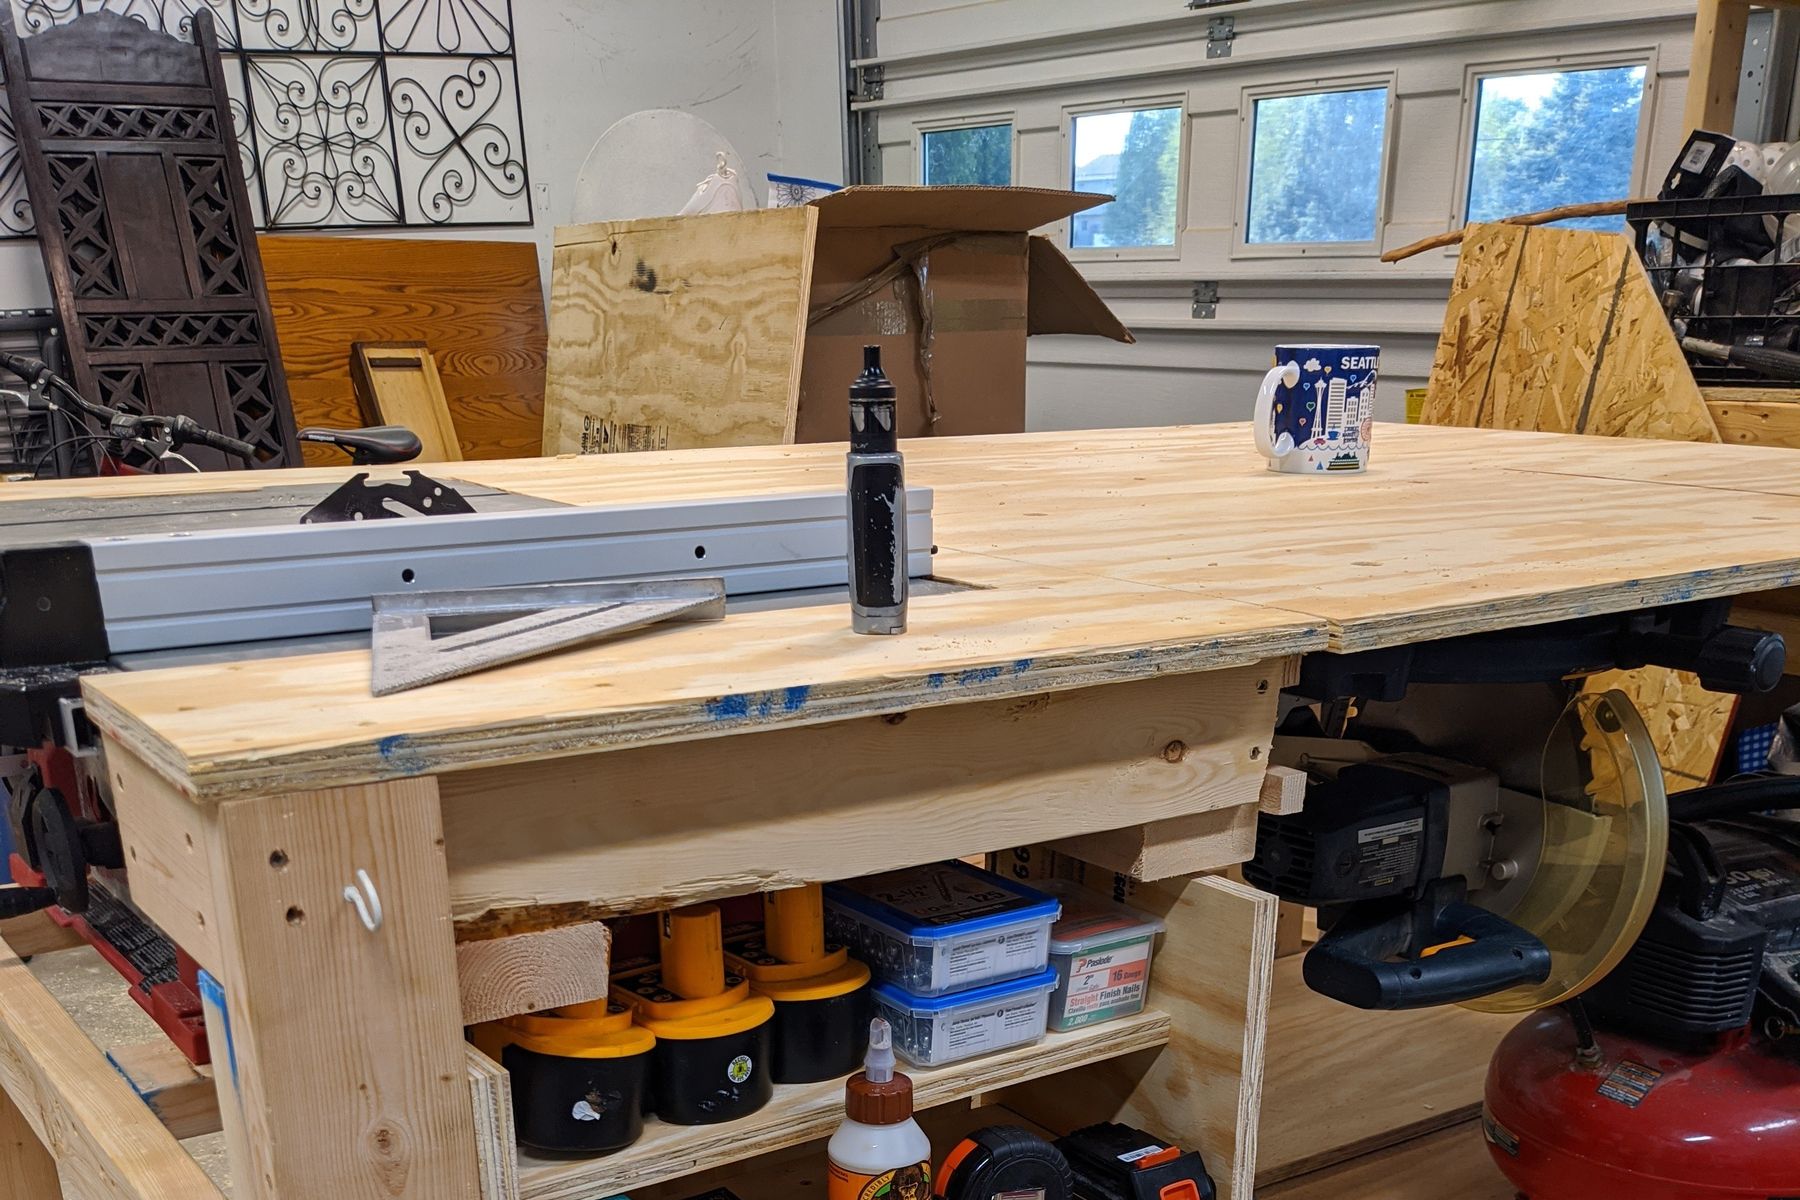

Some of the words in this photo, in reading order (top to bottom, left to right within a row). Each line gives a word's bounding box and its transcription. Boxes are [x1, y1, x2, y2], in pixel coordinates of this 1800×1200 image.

[1086, 955, 1114, 968] Paslode
[1112, 970, 1123, 981] 16
[1070, 992, 1099, 1007] Straight
[1100, 989, 1121, 1001] Finish
[1122, 984, 1140, 994] Nails
